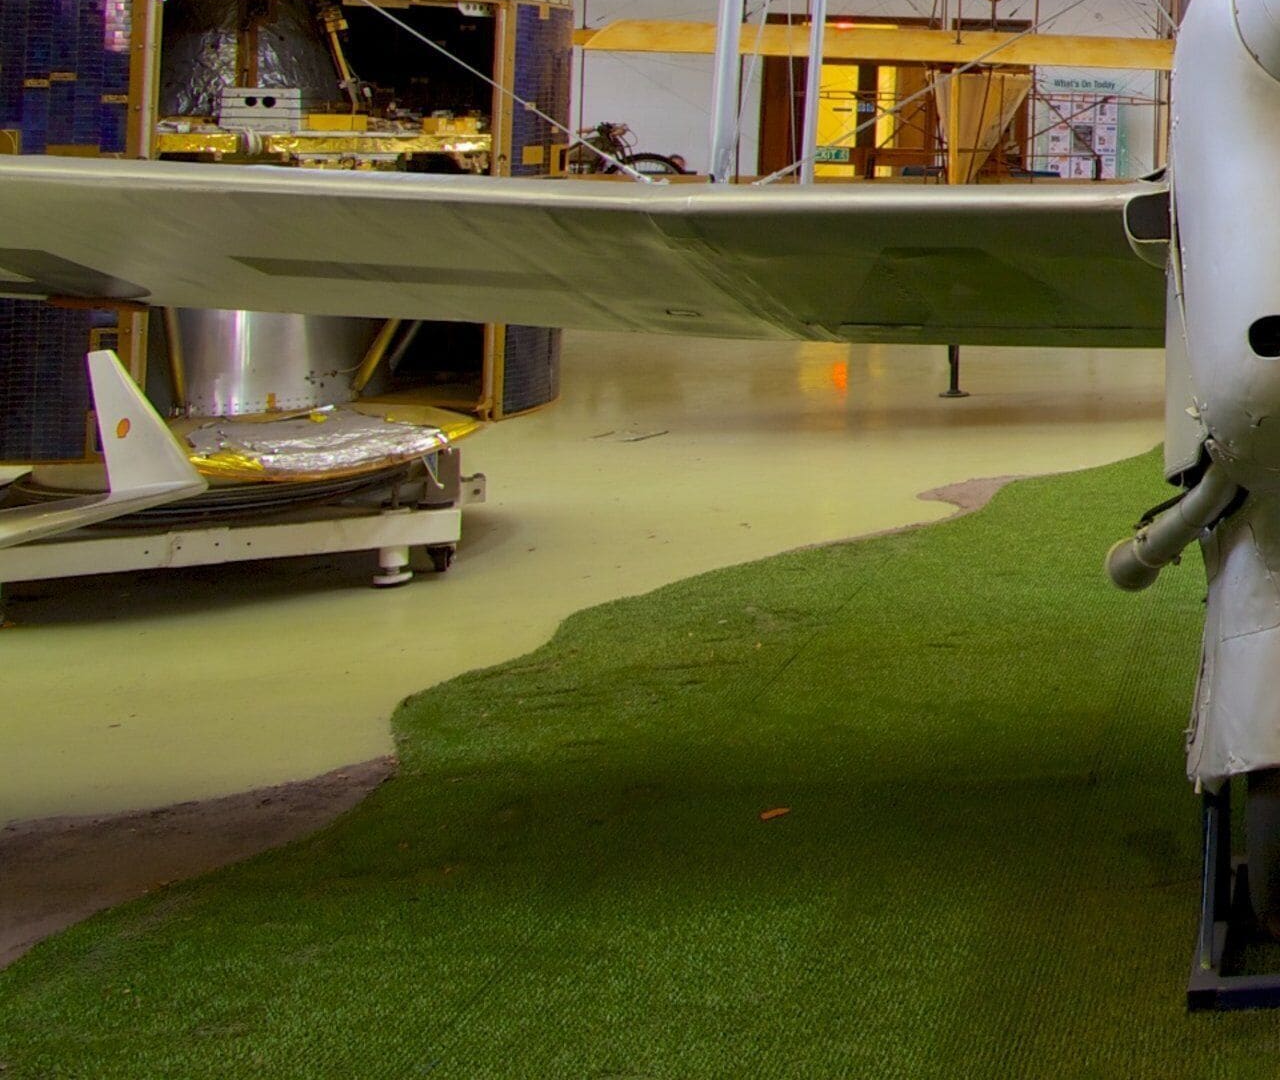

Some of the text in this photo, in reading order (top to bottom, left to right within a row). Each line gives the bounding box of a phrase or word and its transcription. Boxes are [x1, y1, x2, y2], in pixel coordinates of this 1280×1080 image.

[1054, 79, 1116, 89] What's On Today
